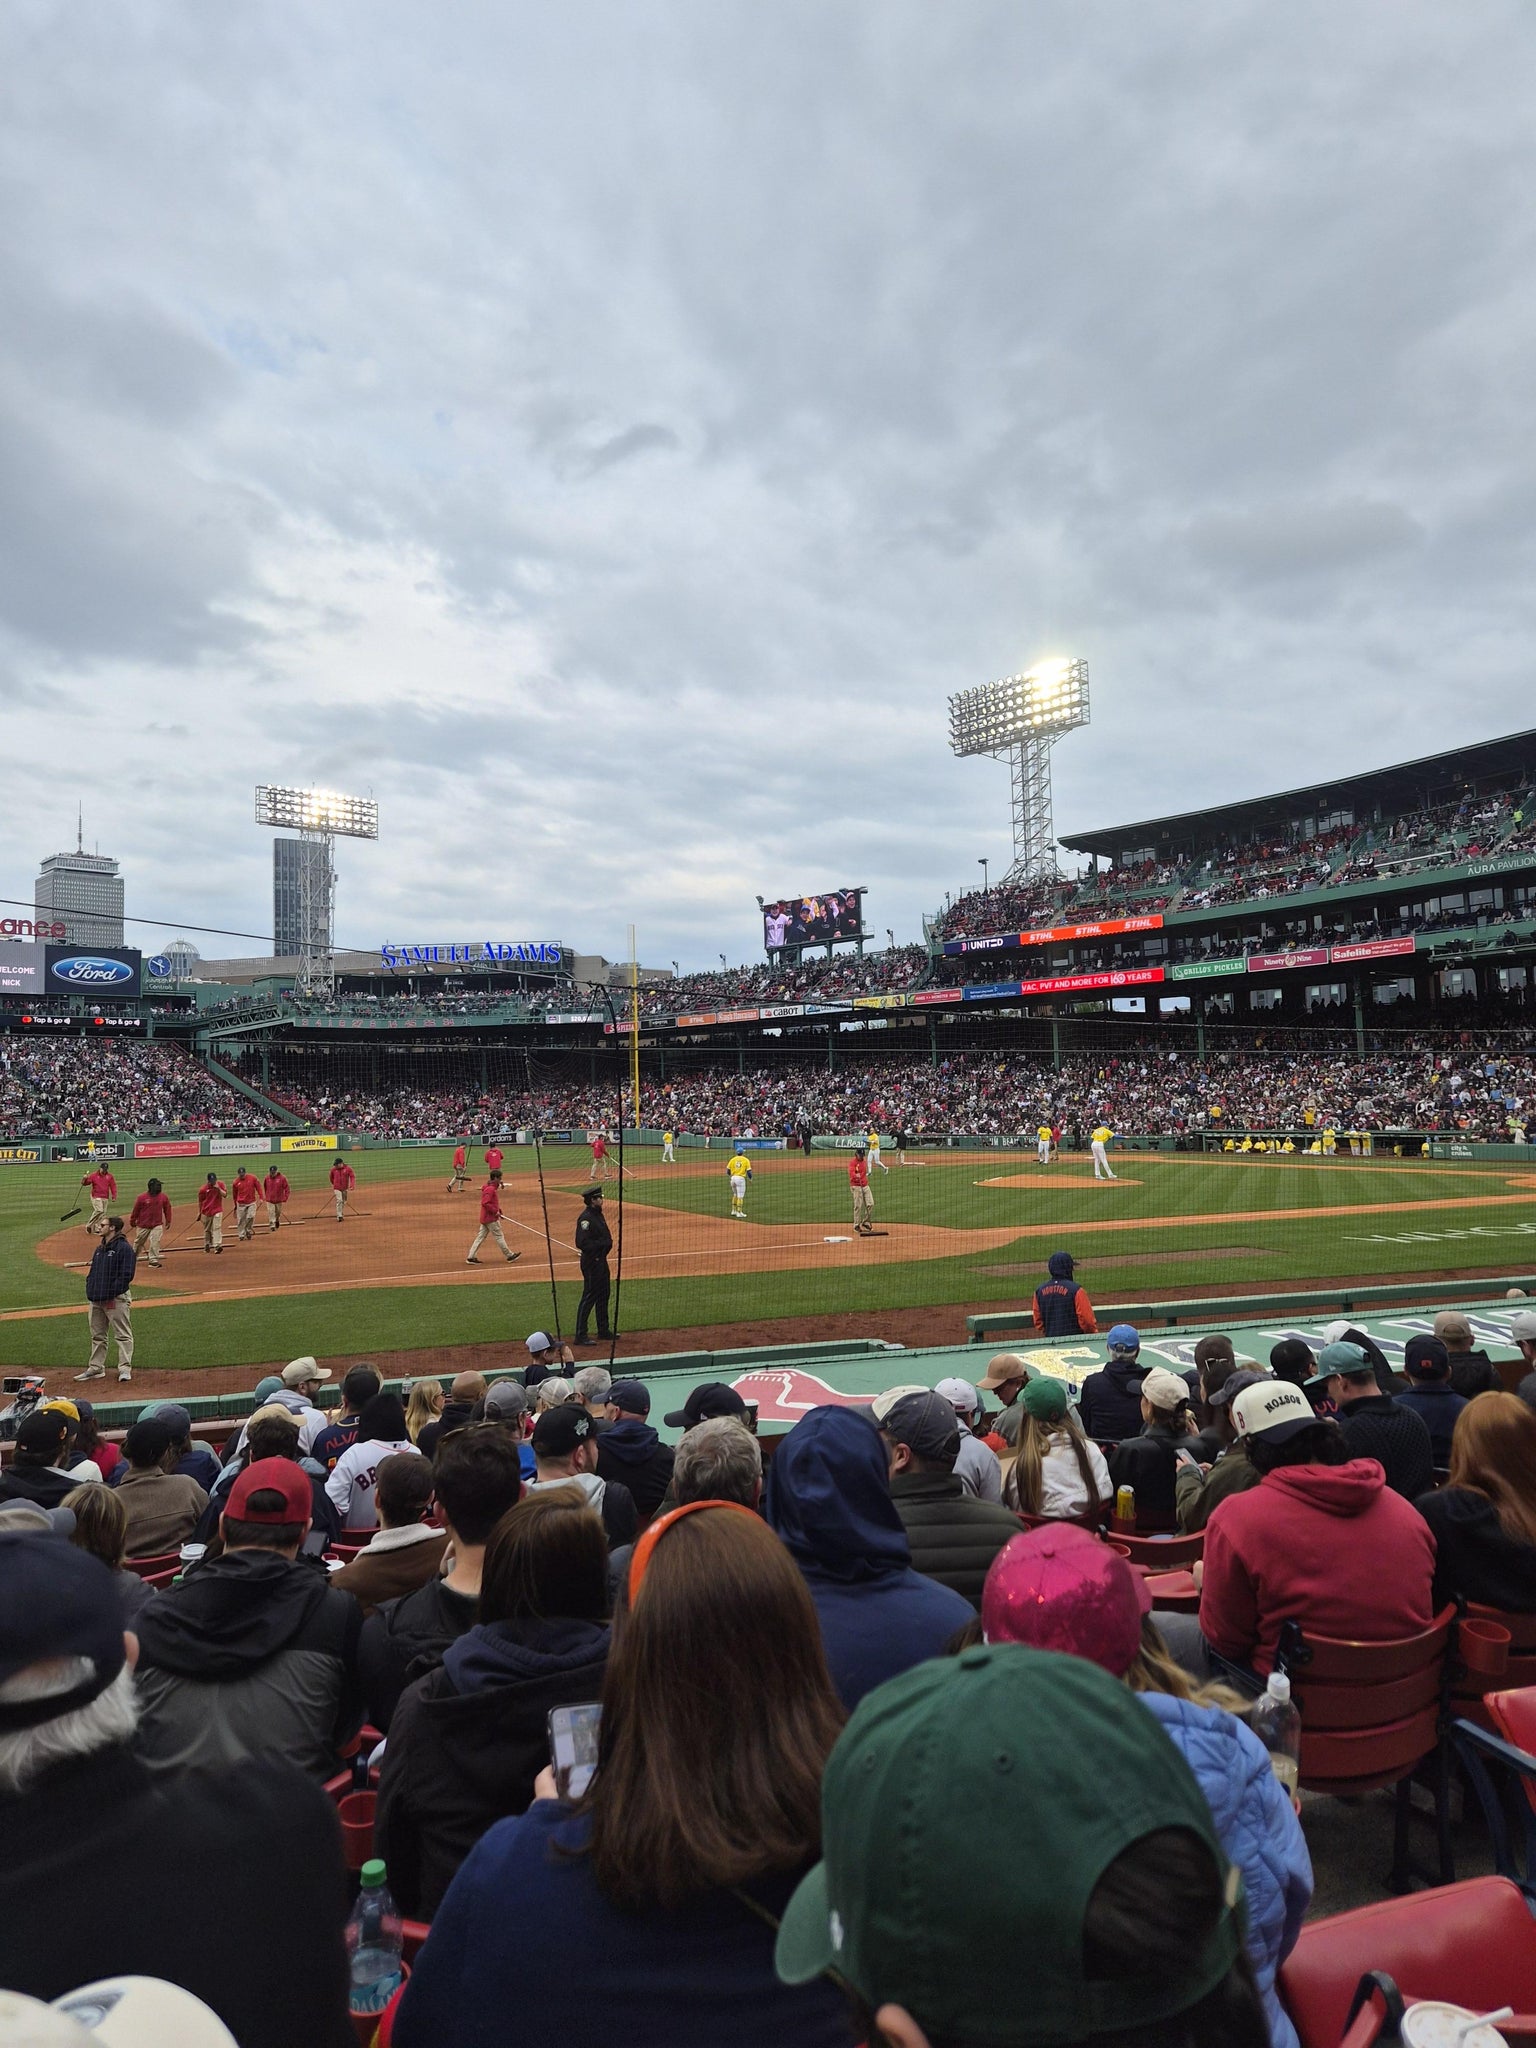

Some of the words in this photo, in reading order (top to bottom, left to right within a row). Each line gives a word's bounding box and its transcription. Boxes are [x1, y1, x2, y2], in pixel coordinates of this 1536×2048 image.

[1124, 918, 1153, 930] STIHL
[1074, 925, 1102, 936] STIHL
[1029, 931, 1054, 942] STIHL
[971, 938, 1003, 950] UNITED
[381, 944, 471, 970] SAMUEL
[481, 940, 561, 964] ADAMS
[1333, 948, 1371, 959] Safelite
[1264, 958, 1285, 967] Ninety
[1296, 955, 1312, 963] Nine
[68, 960, 117, 981] Ford
[1183, 966, 1211, 976] GRILLO'S
[1214, 962, 1243, 973] PICKLES
[2, 979, 21, 987] NICK
[1054, 980, 1070, 989] AND
[1071, 978, 1092, 987] MORE
[1094, 977, 1108, 985] FOR
[1110, 973, 1126, 984] 160
[1127, 972, 1152, 982] YEARS
[33, 1016, 46, 1024] Tap
[105, 1018, 117, 1026] Tap
[78, 1144, 118, 1155] wsabi
[291, 1140, 316, 1149] TWISTED
[316, 1140, 327, 1148] TEA
[1041, 1285, 1068, 1296] HOUSTON
[1264, 1394, 1302, 1413] BOSTON
[1236, 1411, 1245, 1429] B
